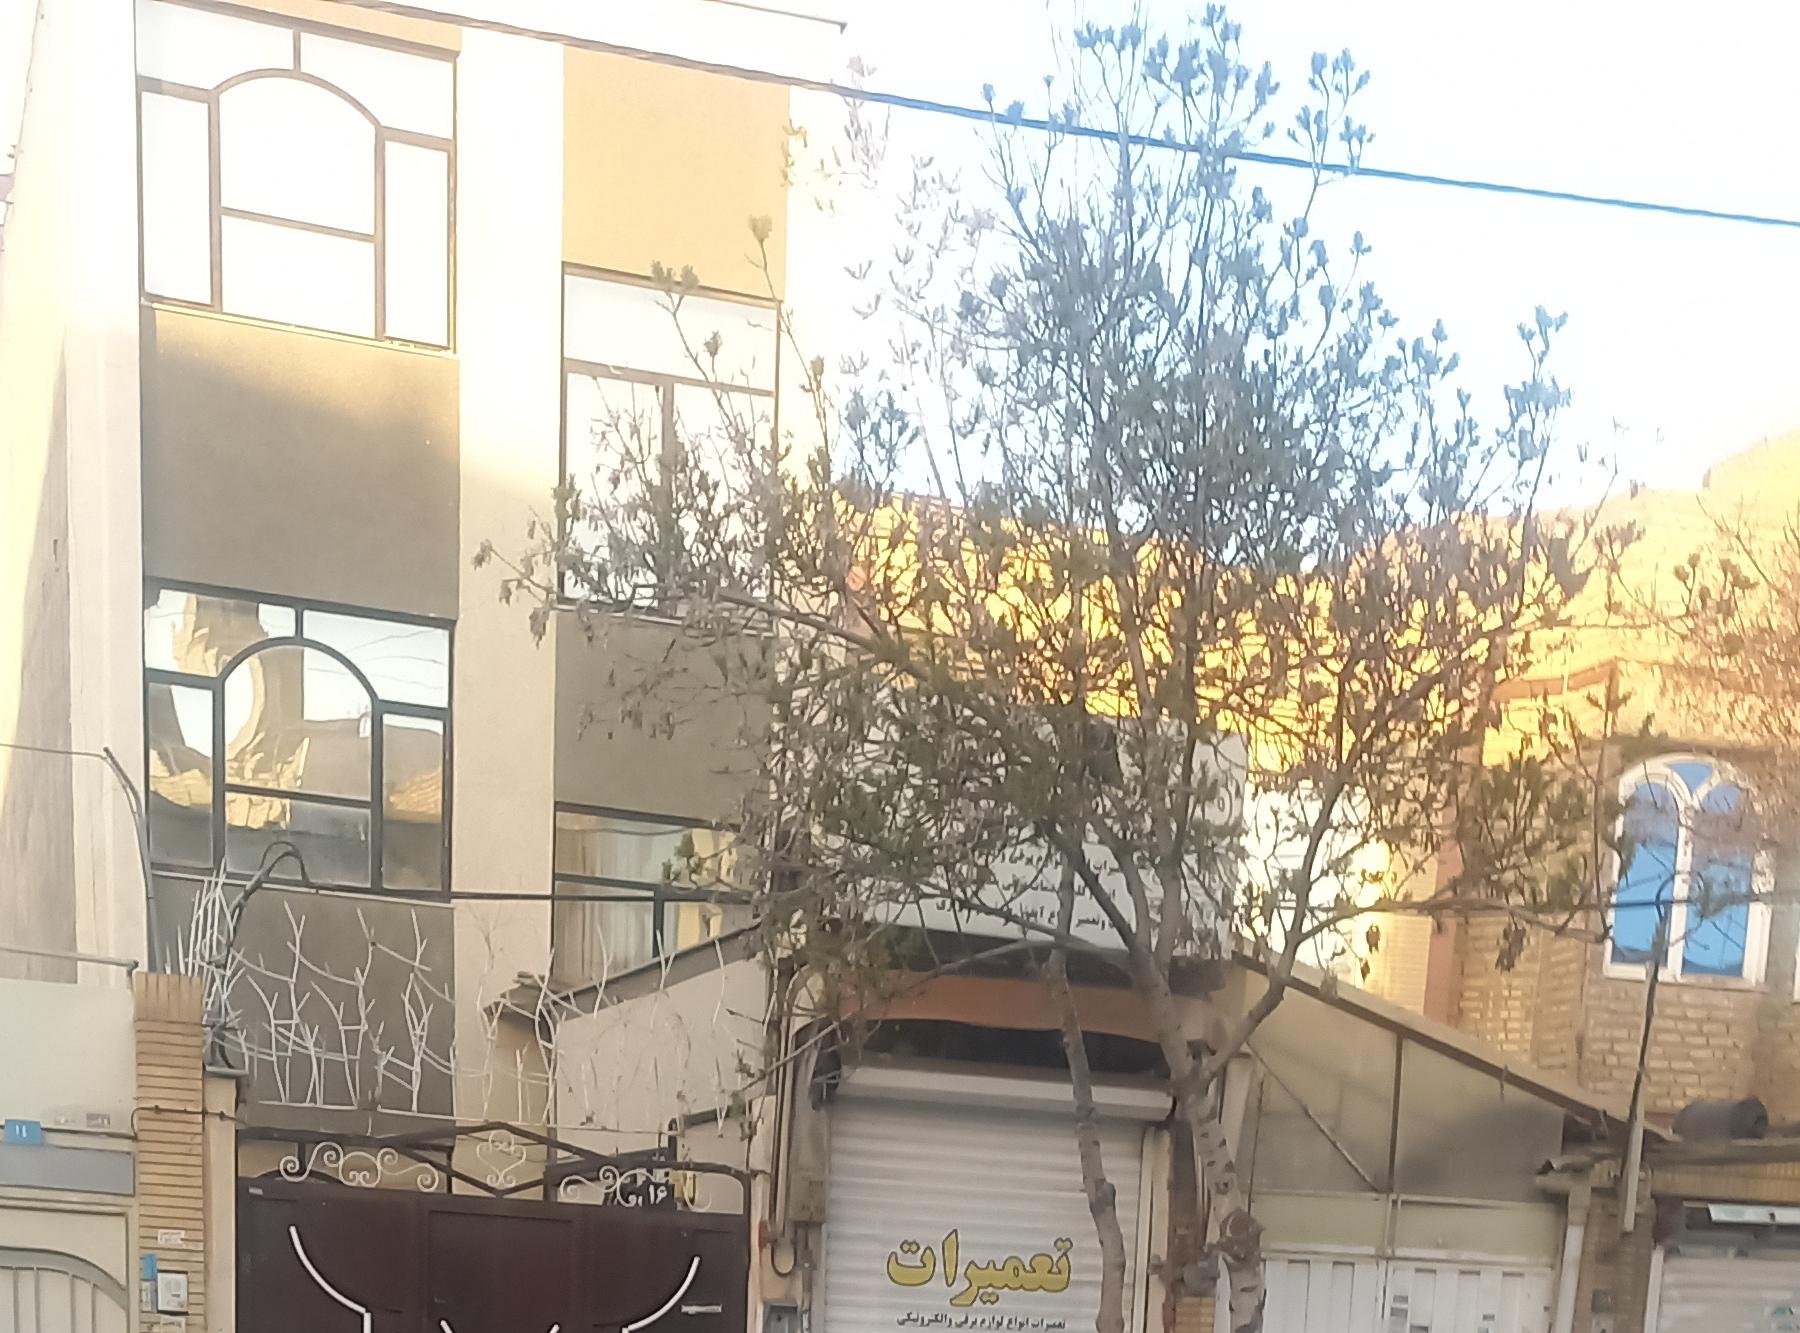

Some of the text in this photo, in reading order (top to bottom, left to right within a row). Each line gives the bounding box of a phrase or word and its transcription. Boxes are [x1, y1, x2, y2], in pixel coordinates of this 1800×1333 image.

[886, 1228, 1073, 1307] تعمیرات
[954, 1312, 978, 1329] برقی
[980, 1314, 1004, 1331] لوازم
[1006, 1315, 1029, 1331] انواع
[1030, 1317, 1065, 1332] تعمیرات
